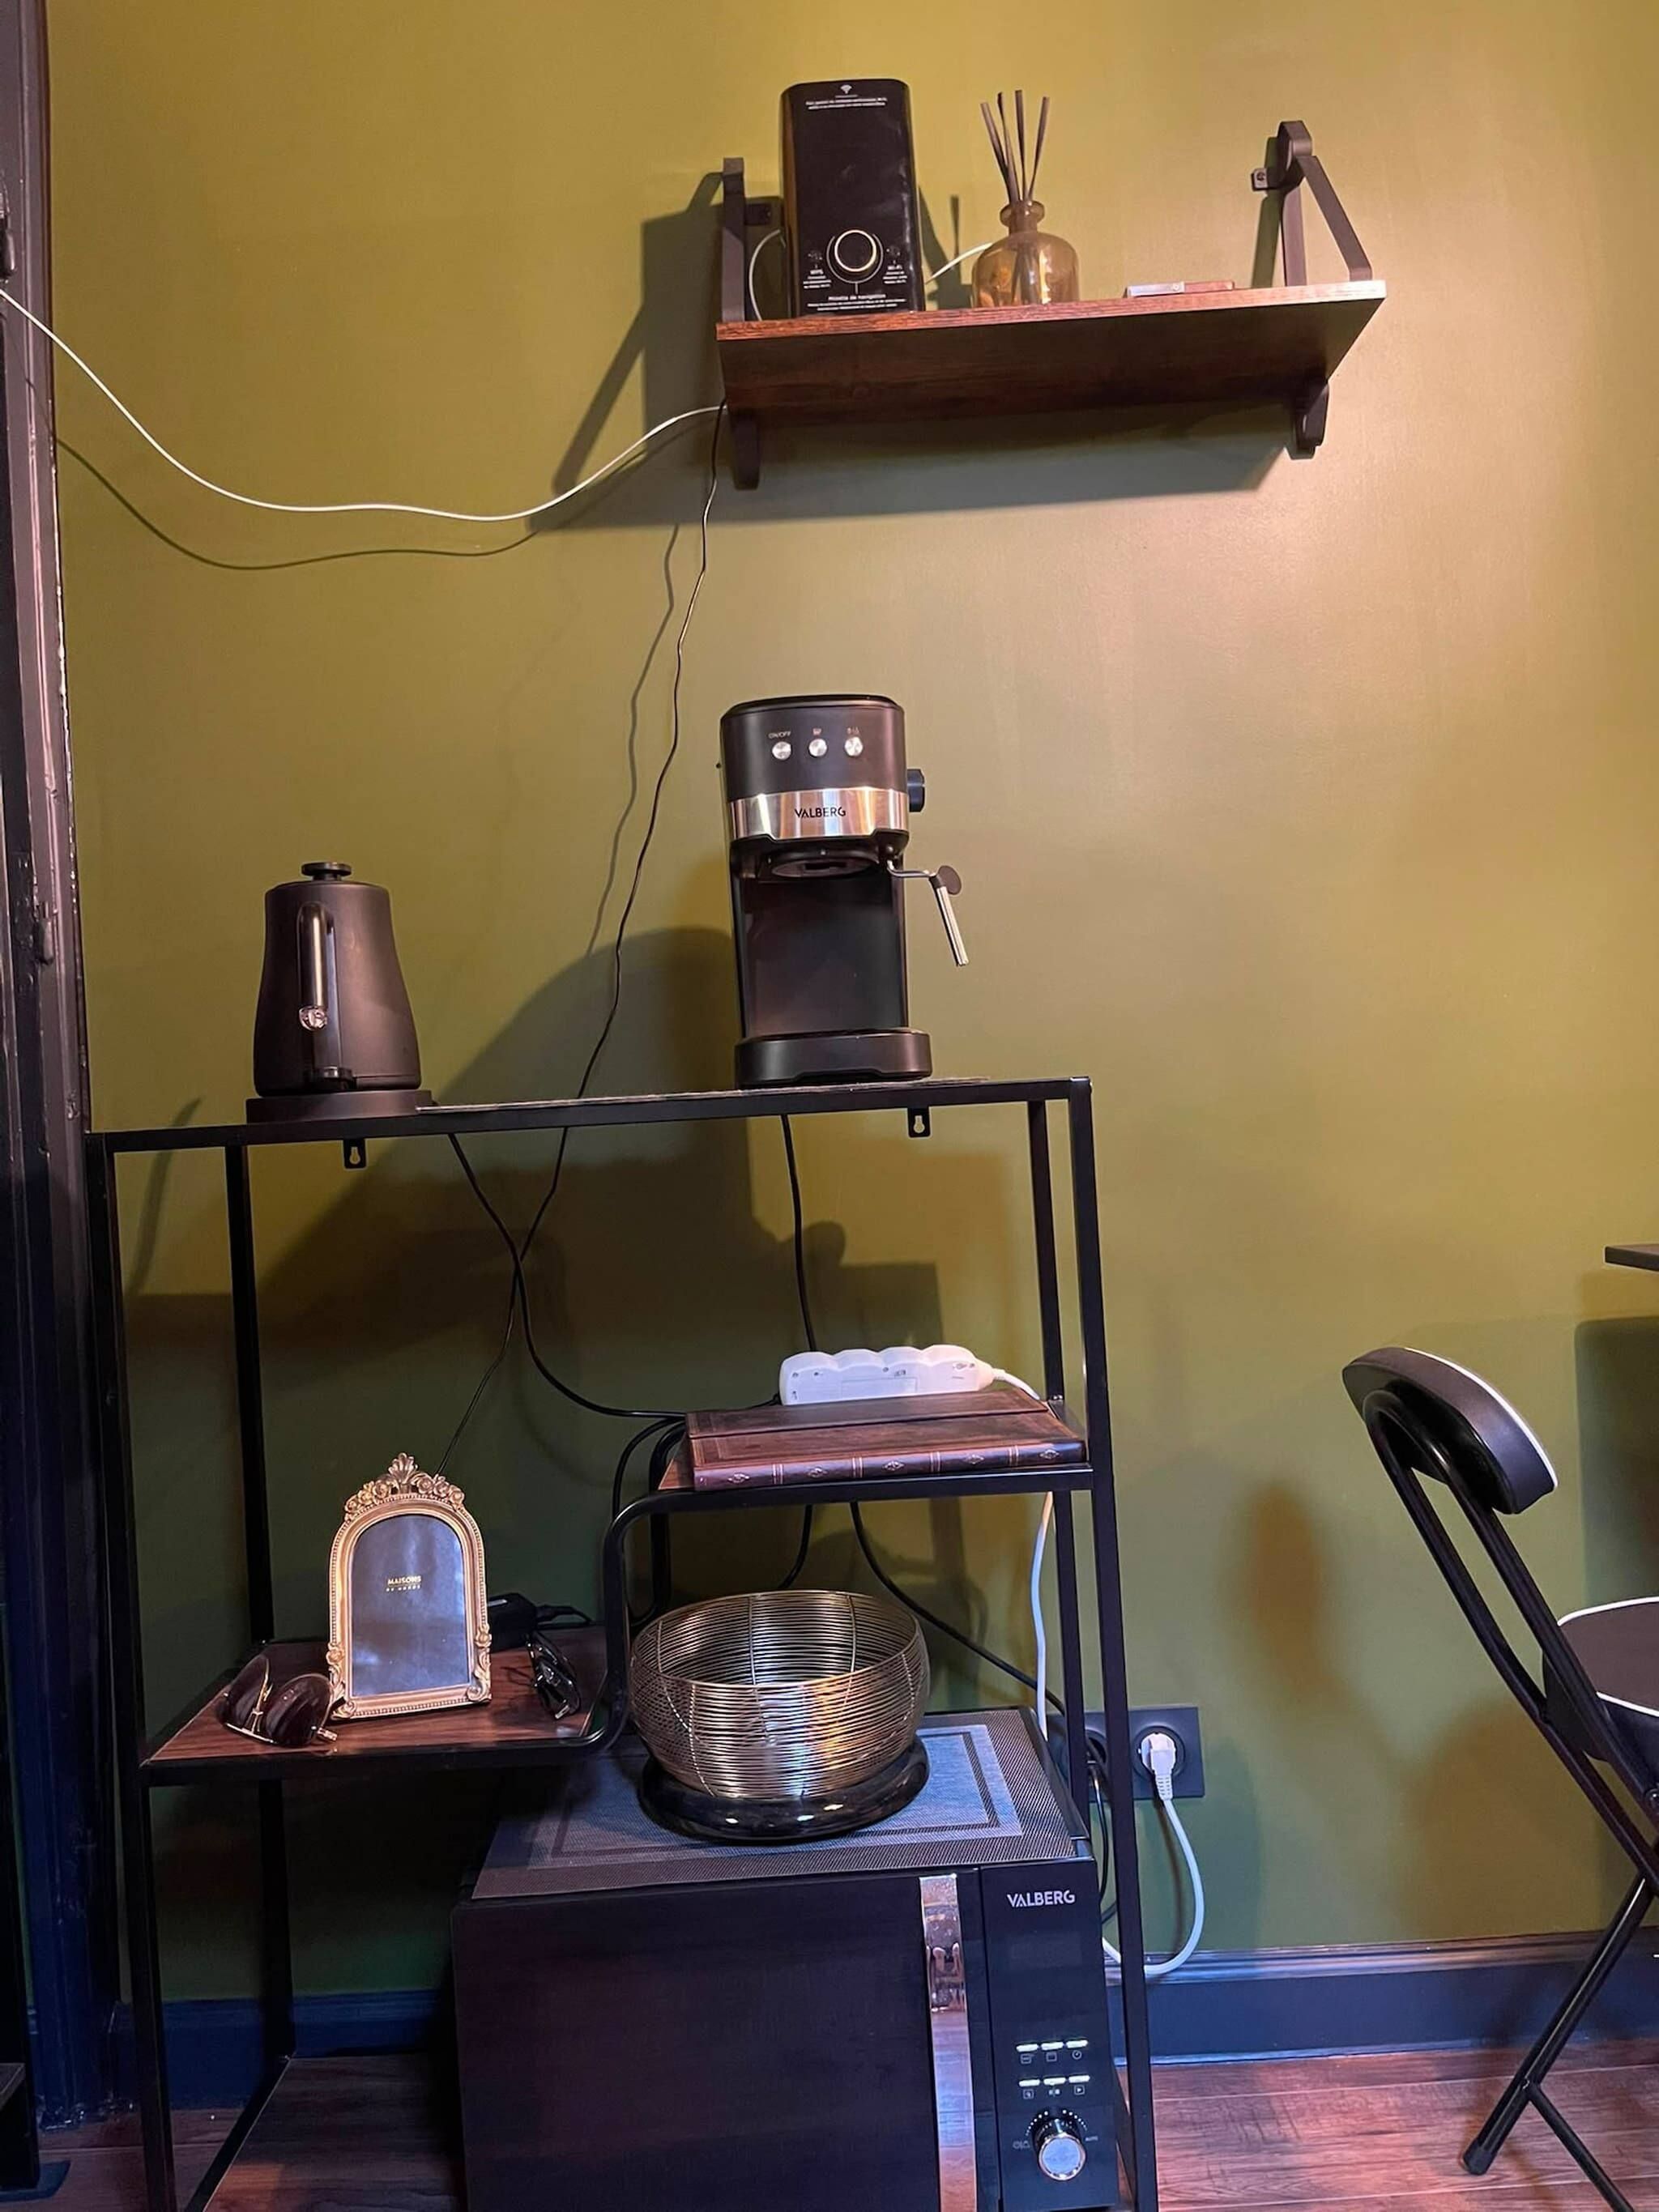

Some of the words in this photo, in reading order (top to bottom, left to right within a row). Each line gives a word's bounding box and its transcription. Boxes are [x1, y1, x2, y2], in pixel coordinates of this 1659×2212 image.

[768, 731, 791, 739] ON/OFF
[794, 807, 847, 818] VALBERG
[387, 1575, 422, 1585] MAISONS
[1006, 1890, 1076, 1907] VALBERG
